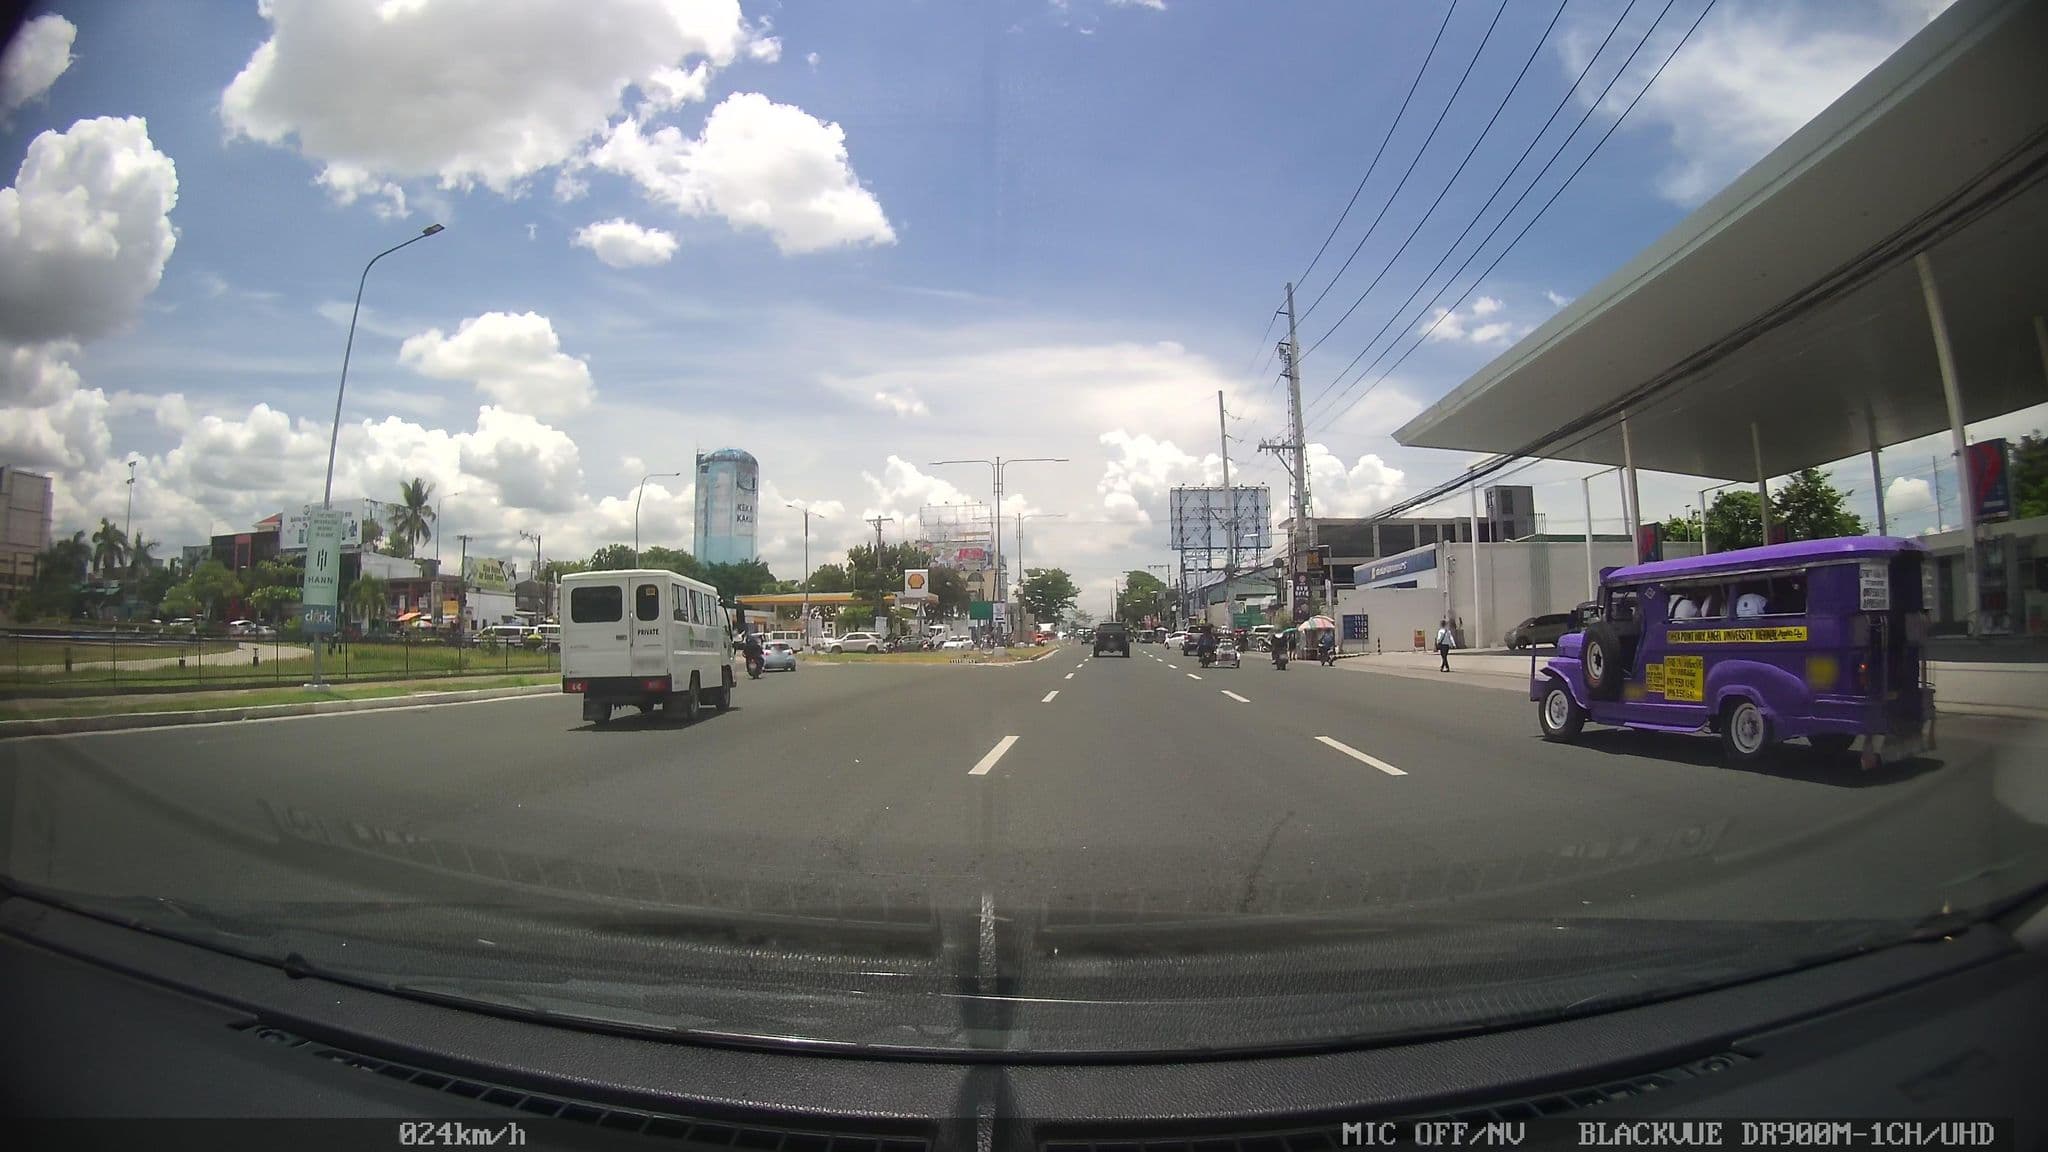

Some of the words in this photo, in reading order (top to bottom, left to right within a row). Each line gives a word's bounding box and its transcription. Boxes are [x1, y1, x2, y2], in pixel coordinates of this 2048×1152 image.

[308, 576, 333, 584] HANN
[637, 628, 659, 636] PRIVATE
[1724, 629, 1753, 641] UNIVERSITY
